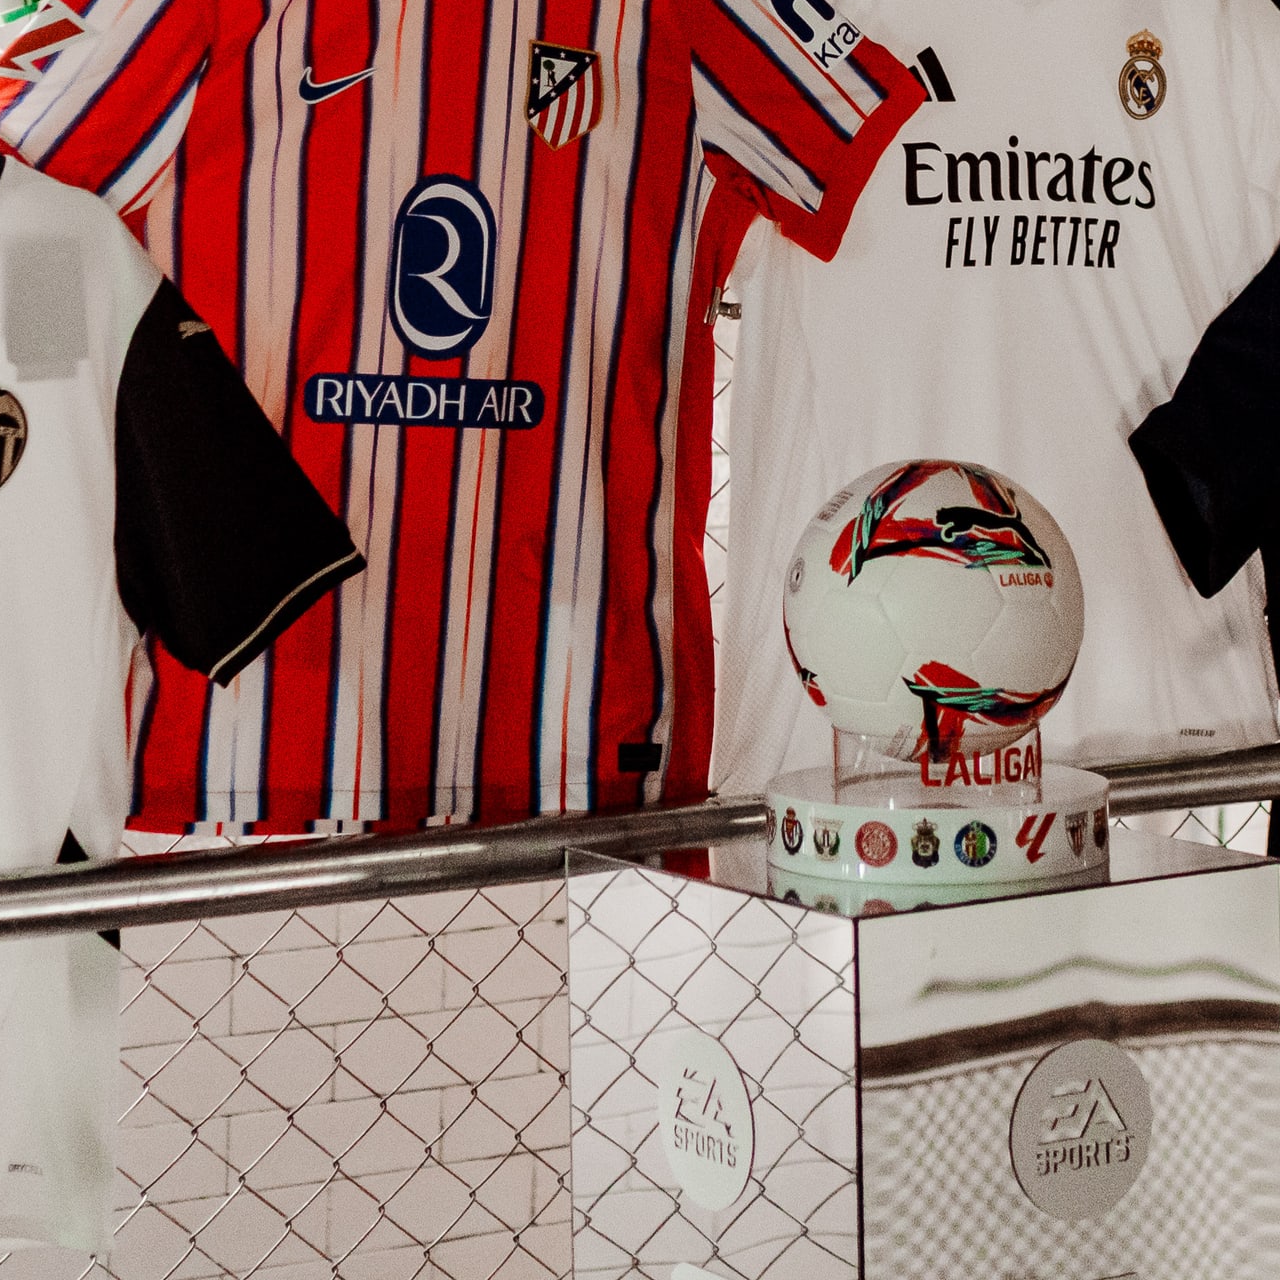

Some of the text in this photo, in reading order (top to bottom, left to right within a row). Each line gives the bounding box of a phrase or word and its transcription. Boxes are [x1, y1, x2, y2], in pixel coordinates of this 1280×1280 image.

[812, 21, 861, 69] kra
[901, 134, 1156, 210] Emirates
[944, 215, 1121, 269] FLY BETTER
[314, 377, 534, 423] RIYADH AIR
[999, 571, 1043, 588] LALIGA
[920, 744, 1036, 788] LALIGA
[673, 1122, 738, 1169] SPORTS
[1036, 1137, 1131, 1177] SPORTS
